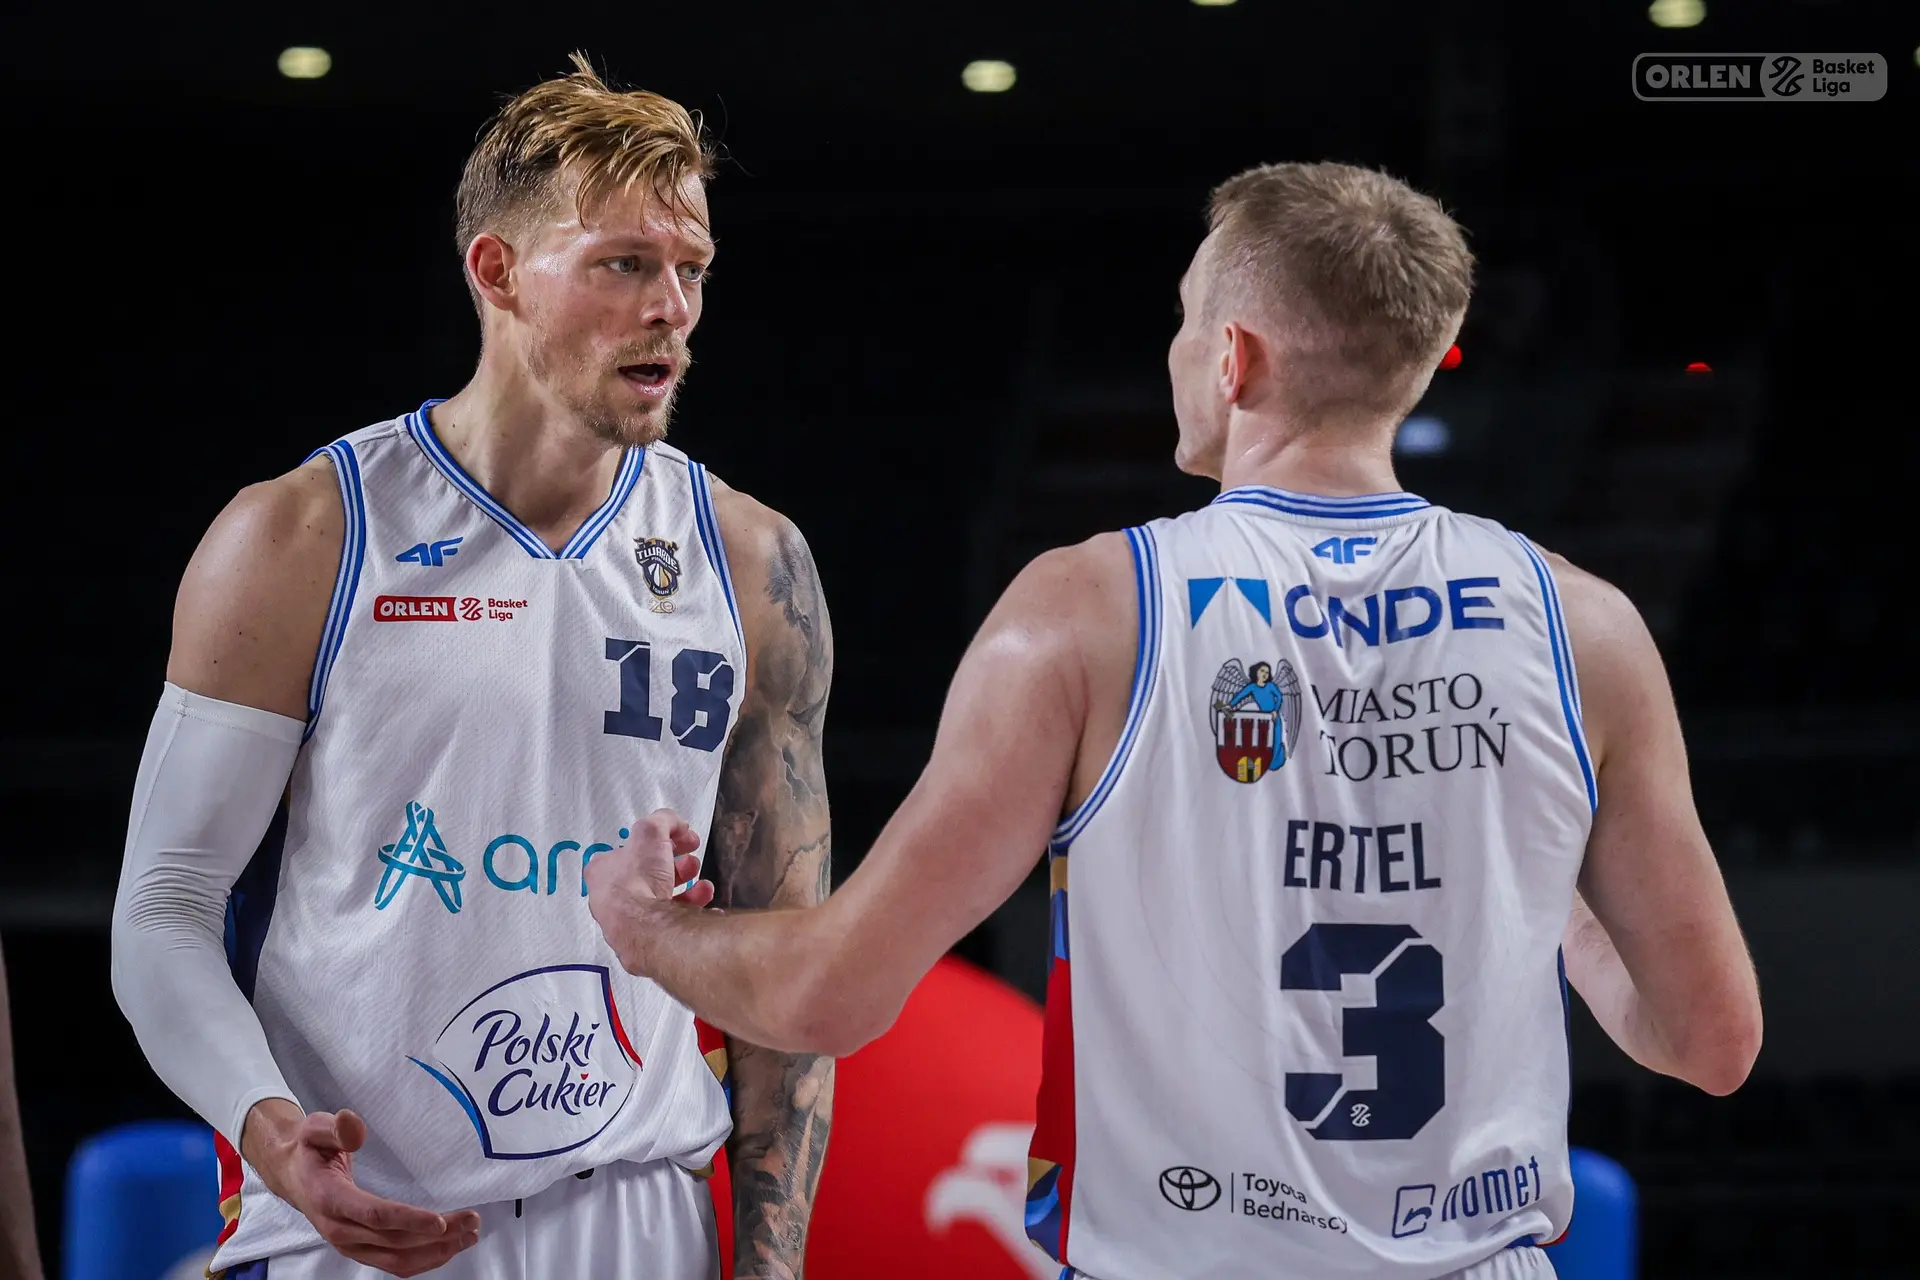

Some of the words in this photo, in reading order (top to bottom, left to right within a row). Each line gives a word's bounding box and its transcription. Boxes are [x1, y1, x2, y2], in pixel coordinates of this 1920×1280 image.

[379, 601, 449, 617] ORLEN
[487, 598, 528, 608] Basket
[488, 609, 514, 622] Liga
[1284, 577, 1505, 648] ONDE
[603, 637, 735, 752] 18
[1310, 672, 1483, 725] MIASTO
[1284, 820, 1442, 894] ERTEL
[472, 1009, 601, 1073] Polski
[1280, 923, 1446, 1141] 3
[488, 1063, 617, 1117] Cukier
[1242, 1173, 1307, 1204] Toyota
[1441, 1155, 1541, 1222] nomet
